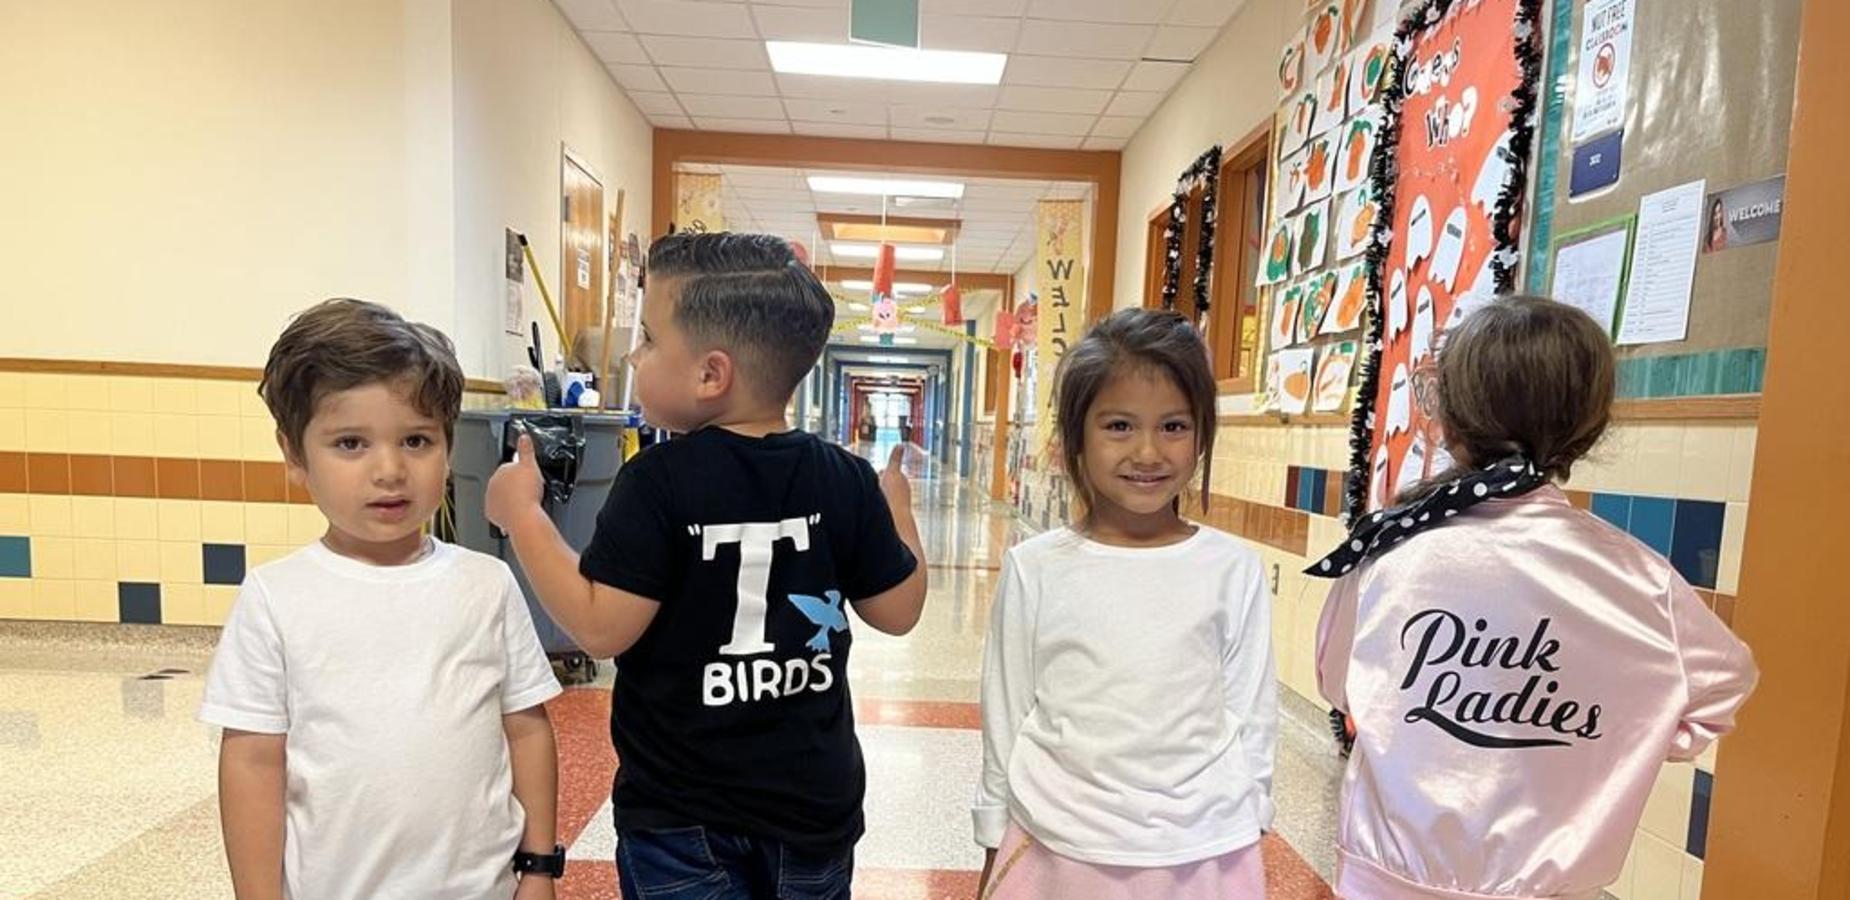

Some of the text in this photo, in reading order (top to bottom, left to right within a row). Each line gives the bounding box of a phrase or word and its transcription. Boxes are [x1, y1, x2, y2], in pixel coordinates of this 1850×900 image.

[1728, 200, 1782, 222] WELCOME
[703, 653, 834, 706] BIRDS
[1400, 609, 1561, 690] Pink
[1404, 671, 1602, 749] Ladies
